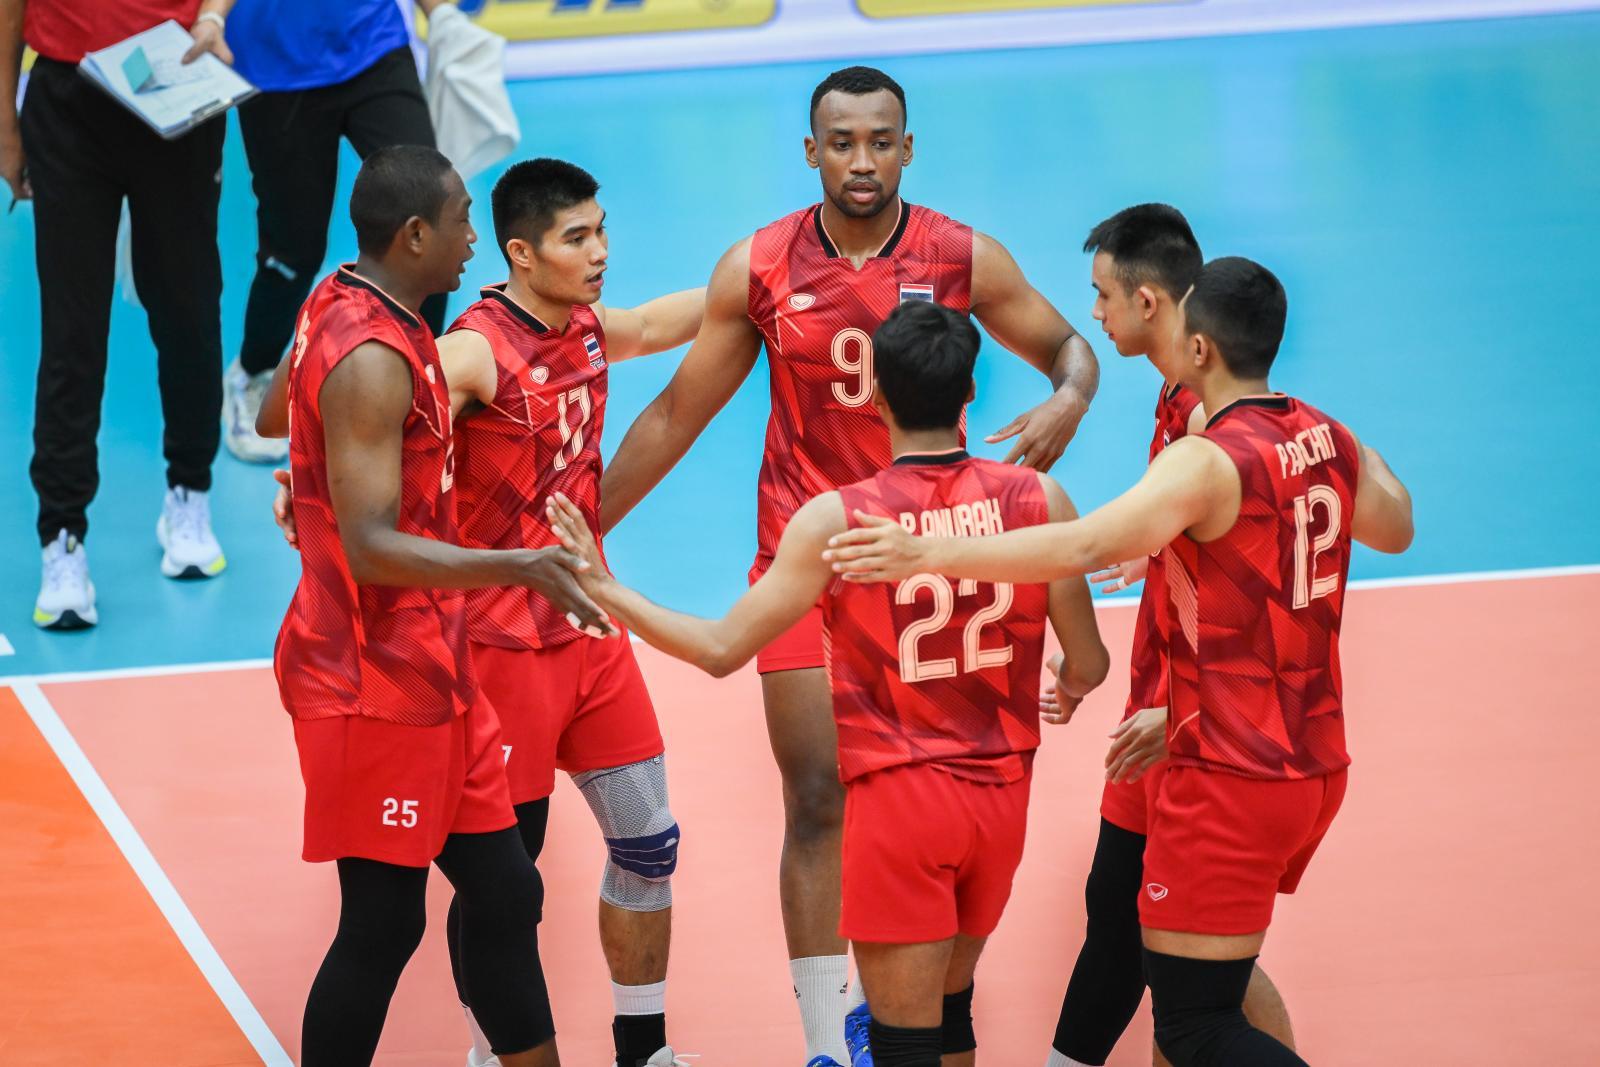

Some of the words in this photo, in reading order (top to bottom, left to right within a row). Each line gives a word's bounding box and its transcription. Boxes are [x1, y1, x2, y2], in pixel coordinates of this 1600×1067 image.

[830, 327, 874, 408] 9
[553, 383, 591, 471] 17
[1292, 484, 1341, 610] 12
[895, 572, 1014, 683] 22
[382, 797, 419, 829] 25
